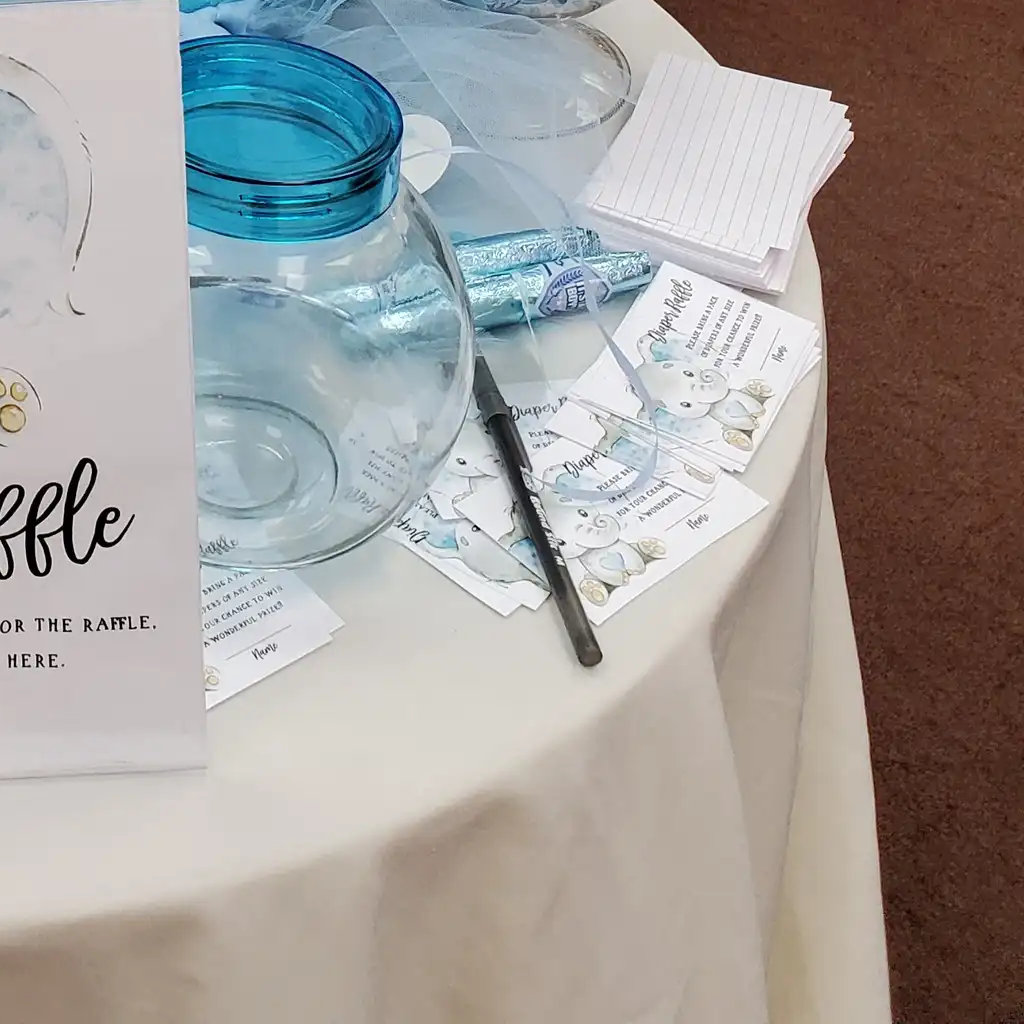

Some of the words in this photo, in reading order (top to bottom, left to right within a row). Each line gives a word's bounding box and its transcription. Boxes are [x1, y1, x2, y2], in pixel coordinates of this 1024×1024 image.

[648, 309, 677, 344] Diaper
[663, 278, 694, 313] Raffle
[685, 329, 701, 350] PLEASE
[509, 401, 559, 423] Diaper
[563, 449, 608, 478] Diape
[597, 472, 622, 492] PLEASE
[616, 504, 630, 518] FOR
[628, 493, 648, 509] YOUR
[637, 513, 646, 522] A
[646, 491, 682, 517] WONDERFUL
[395, 517, 431, 544] Diap
[686, 513, 710, 531] Name
[200, 536, 238, 556] affle
[202, 578, 226, 596] BRING
[201, 600, 221, 614] PERS
[222, 593, 232, 602] OF
[234, 585, 249, 597] ANY
[201, 618, 219, 632] OUR
[221, 601, 251, 621] CHANCE
[252, 595, 264, 604] TO
[266, 585, 284, 598] WIN
[34, 616, 73, 634] THE
[83, 614, 157, 633] RAFFLE.
[211, 617, 257, 642] WONDERFUL
[7, 651, 65, 671] HERE.
[251, 642, 278, 660] Name
